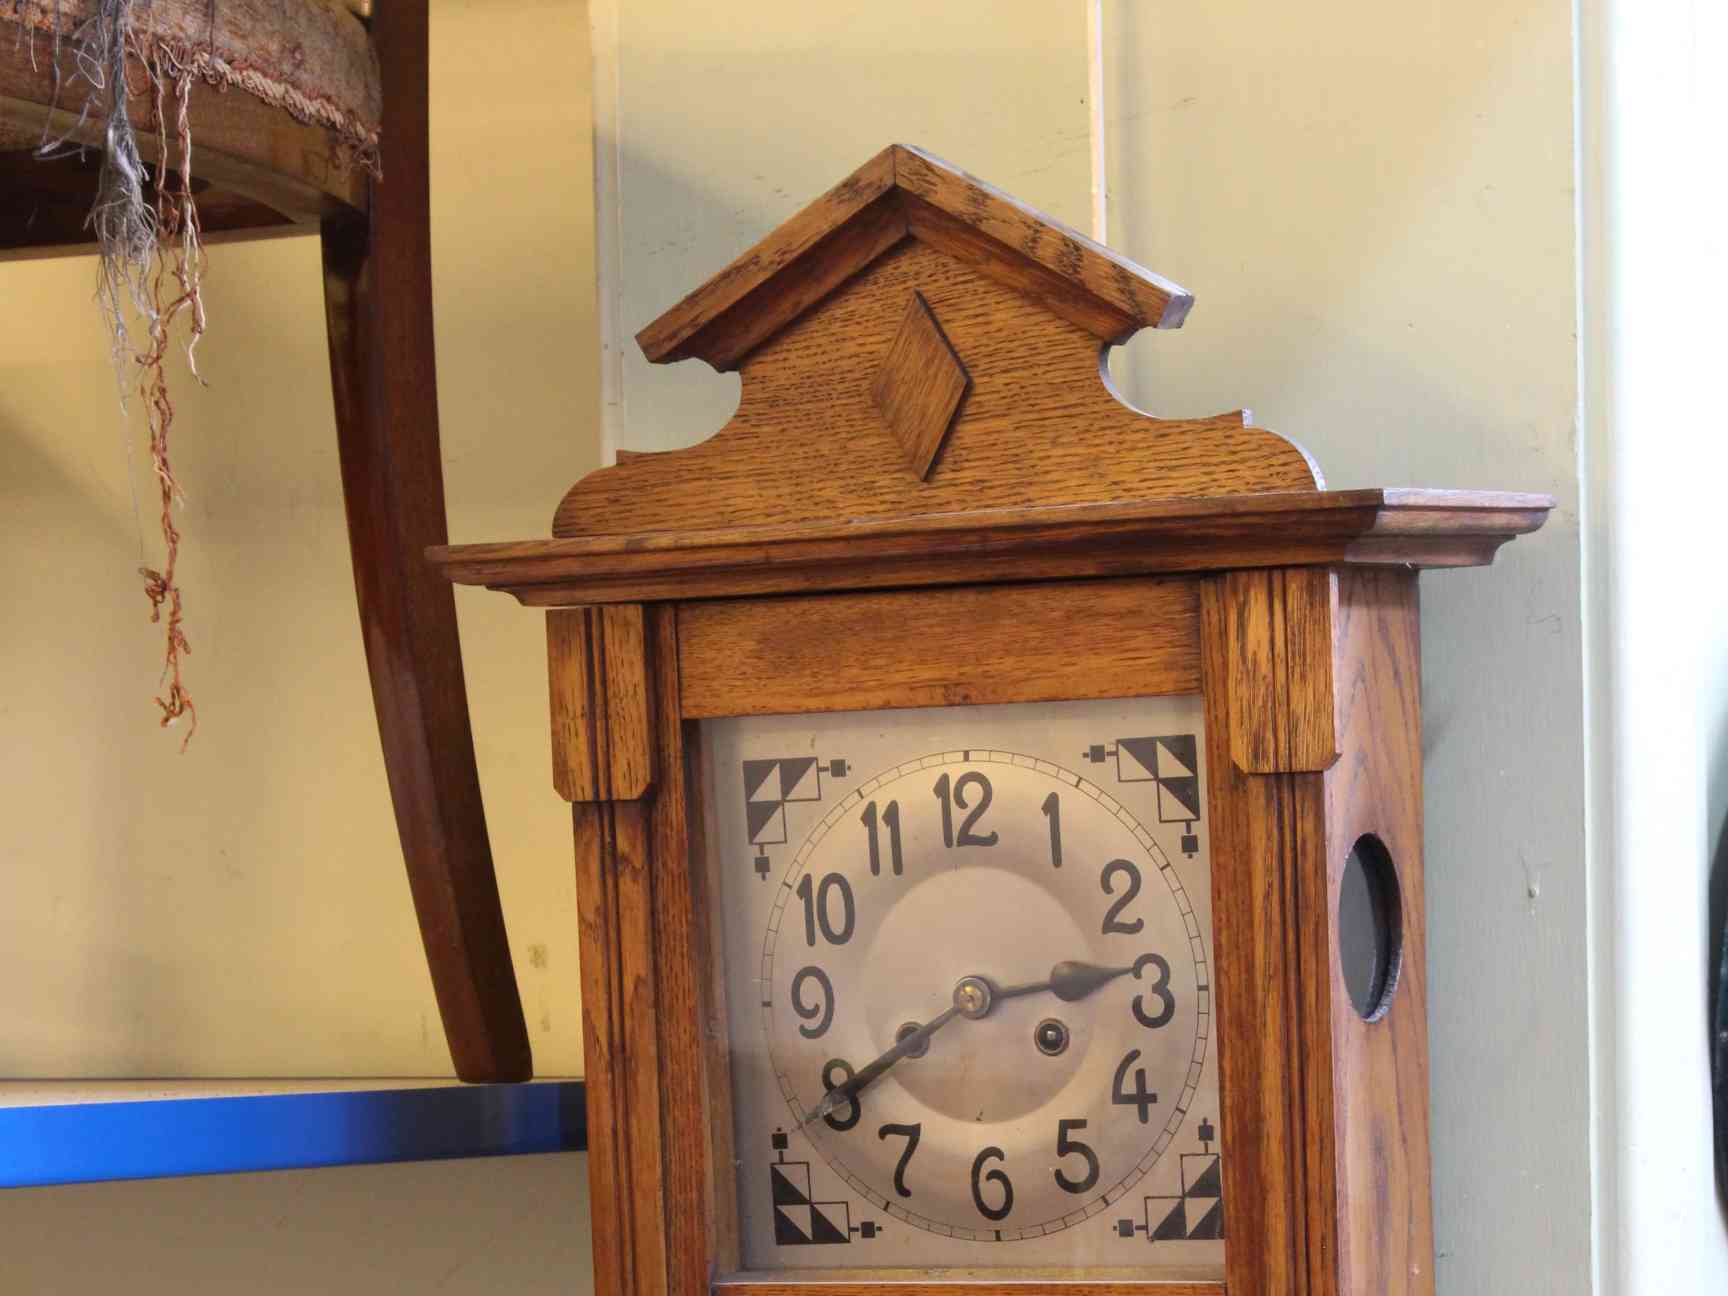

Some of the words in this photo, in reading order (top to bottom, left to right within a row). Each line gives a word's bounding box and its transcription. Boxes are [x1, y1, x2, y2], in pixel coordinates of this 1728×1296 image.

[860, 800, 904, 876] 11
[933, 771, 999, 848] 12
[1041, 792, 1063, 868] 1
[796, 872, 856, 947] 10
[1100, 859, 1145, 935] 2
[791, 966, 835, 1039] 9
[1131, 953, 1176, 1029] 3
[821, 1058, 862, 1131] 8
[1112, 1049, 1158, 1124] 4
[878, 1122, 922, 1198] 7
[971, 1146, 1015, 1221] 6
[1054, 1118, 1100, 1194] 5
